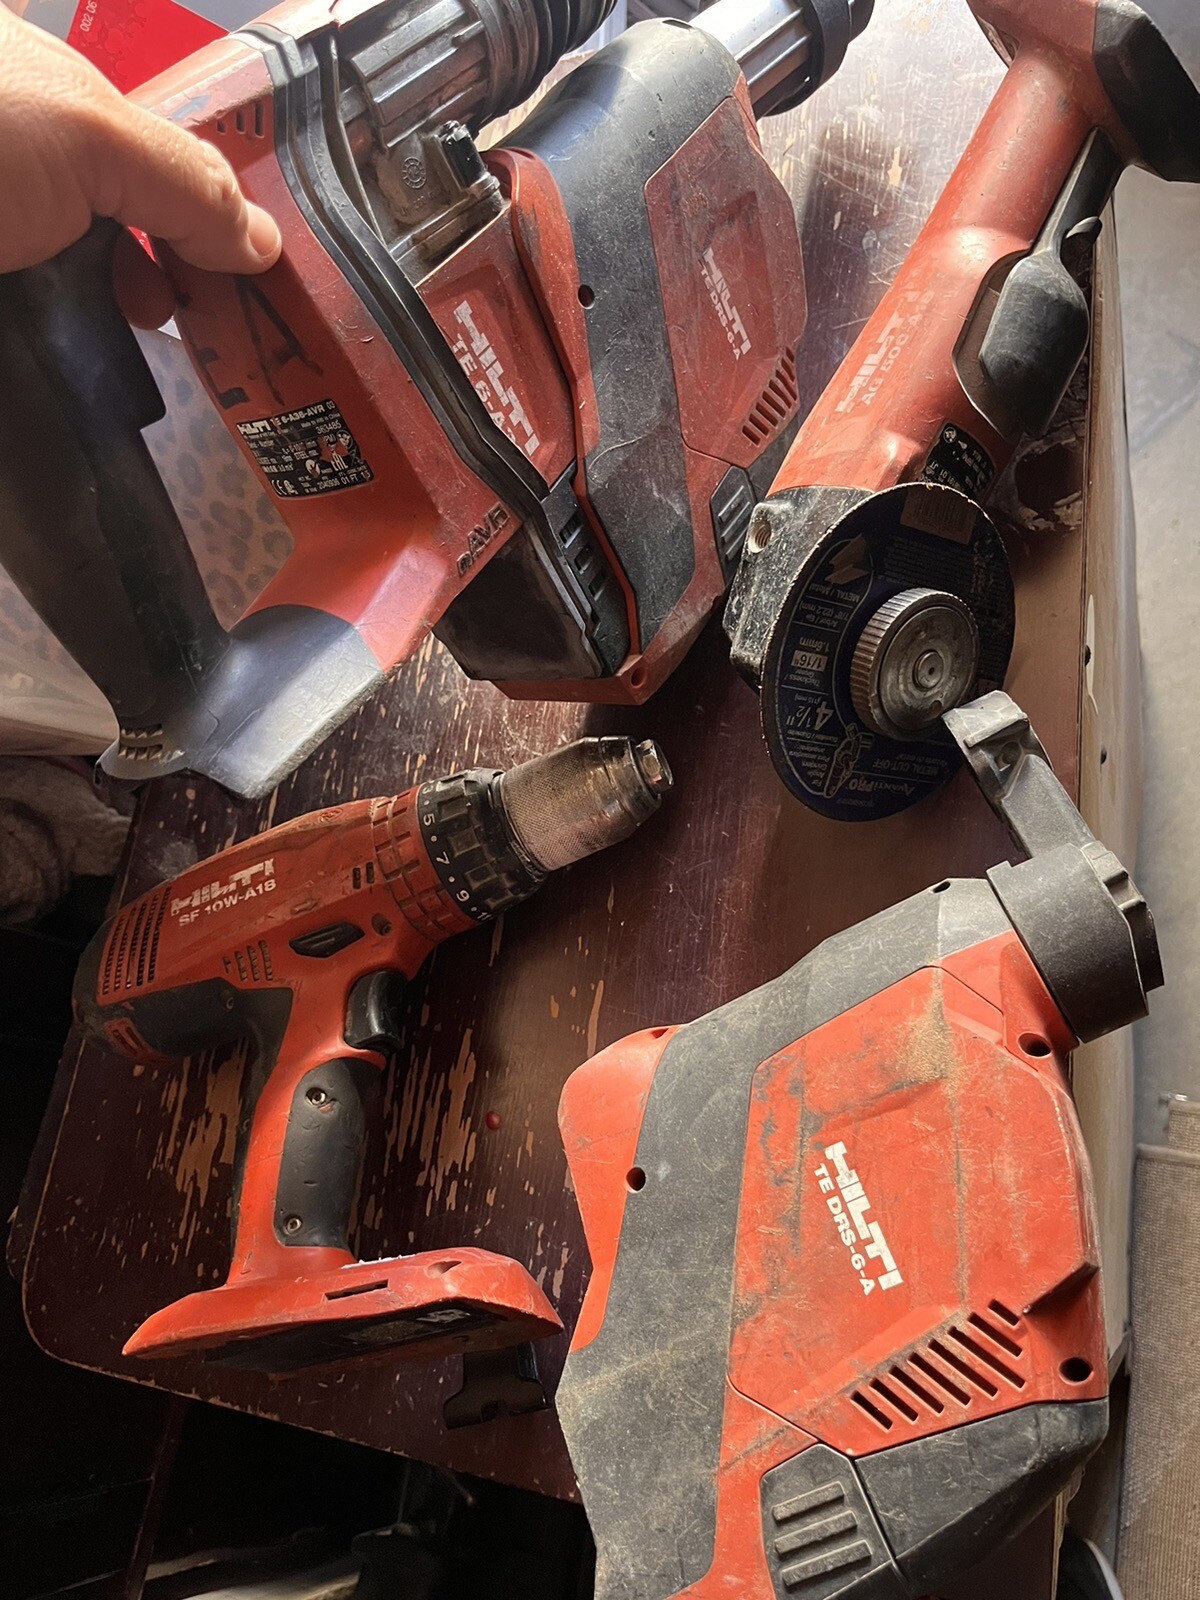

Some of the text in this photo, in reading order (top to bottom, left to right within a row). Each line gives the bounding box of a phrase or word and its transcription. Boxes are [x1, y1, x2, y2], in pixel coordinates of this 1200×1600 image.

[699, 260, 741, 360] TE DRS-6-A
[703, 247, 752, 355] HILTI
[453, 333, 478, 377] TE
[835, 290, 921, 413] HILTI
[453, 300, 540, 457] HILTI
[862, 377, 884, 406] AG
[236, 420, 272, 435] HILTI
[799, 636, 831, 653] 1.6mm
[872, 758, 911, 772] CUT-OFF
[423, 813, 436, 826] 5
[436, 851, 451, 865] 7
[171, 858, 275, 917] HILTI
[178, 878, 277, 927] SF 10W-A18
[456, 889, 470, 902] 9
[813, 1162, 876, 1297] TE DRS-6-A
[824, 1140, 904, 1291] HILTI
